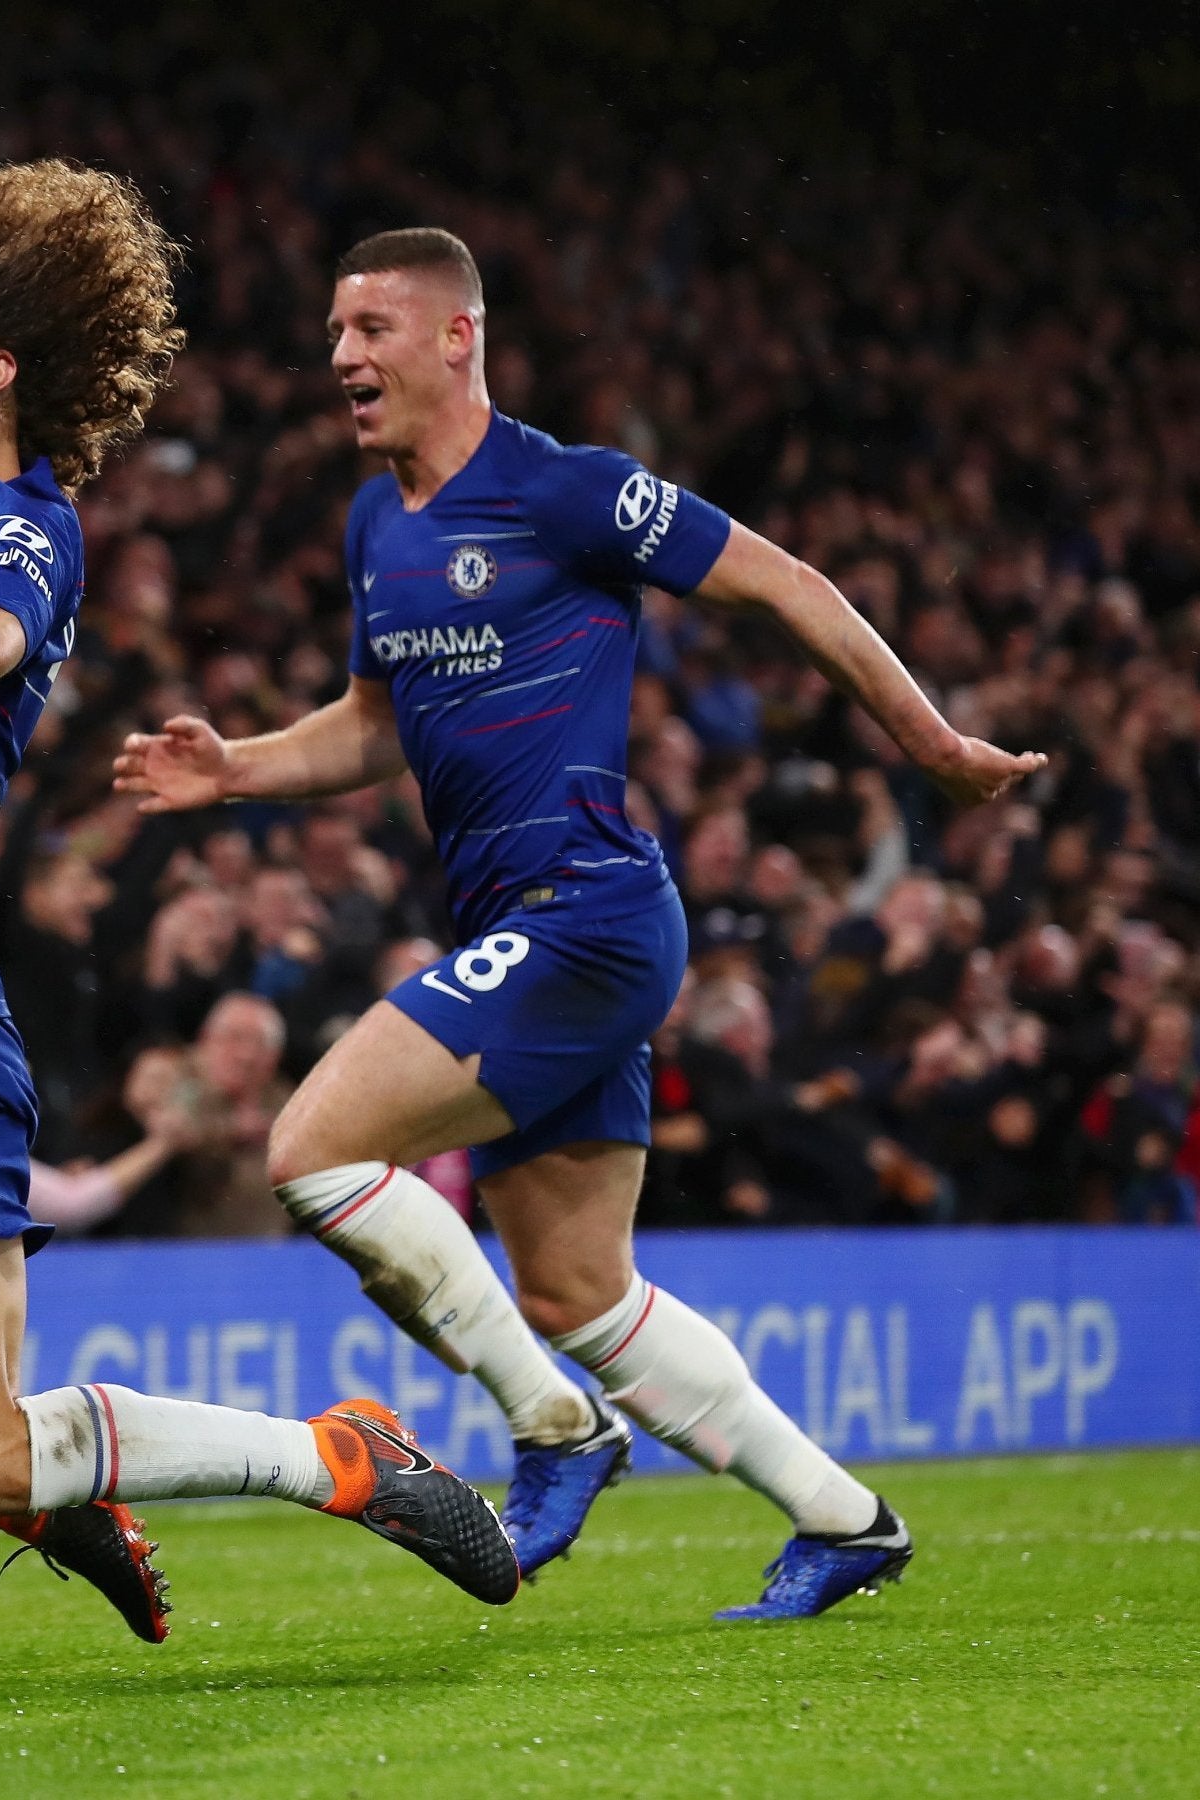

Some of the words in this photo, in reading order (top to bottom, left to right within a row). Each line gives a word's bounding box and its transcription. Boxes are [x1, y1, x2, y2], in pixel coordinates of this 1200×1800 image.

[633, 480, 679, 563] HYUND
[453, 931, 530, 992] 8
[954, 1297, 1121, 1450] APP
